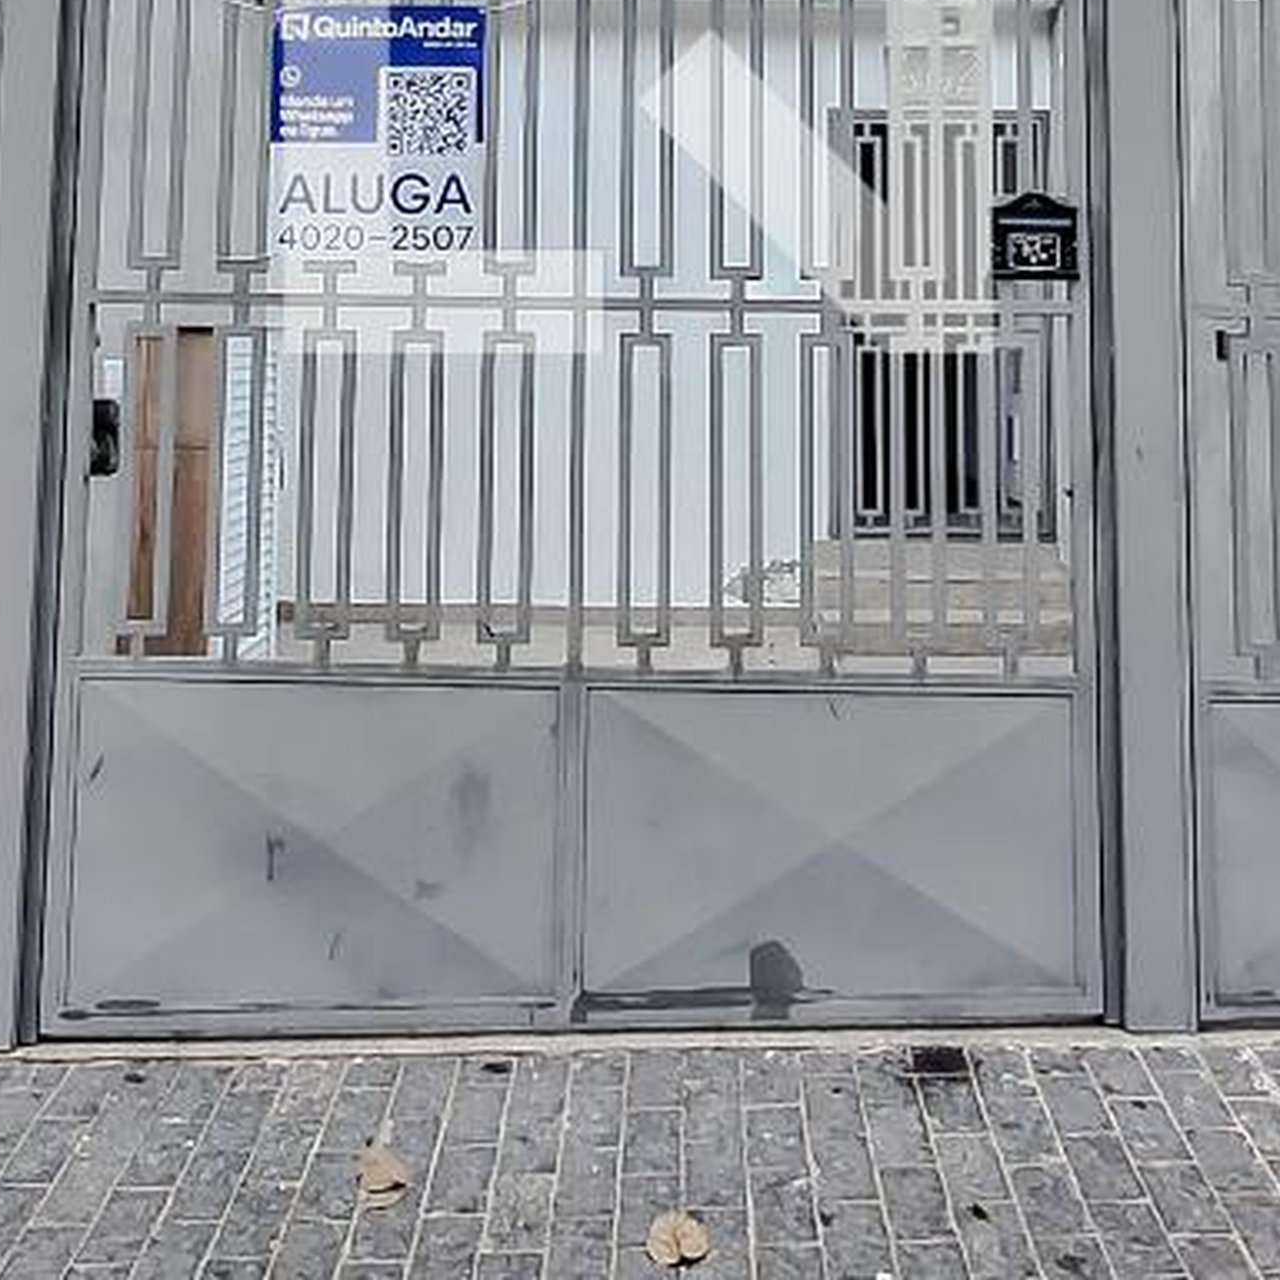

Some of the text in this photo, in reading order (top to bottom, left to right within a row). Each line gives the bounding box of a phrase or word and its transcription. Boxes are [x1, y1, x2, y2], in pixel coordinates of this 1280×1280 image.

[312, 16, 478, 39] QuintoAndar
[278, 173, 473, 215] ALUGA
[278, 224, 474, 251] 4020-2507
